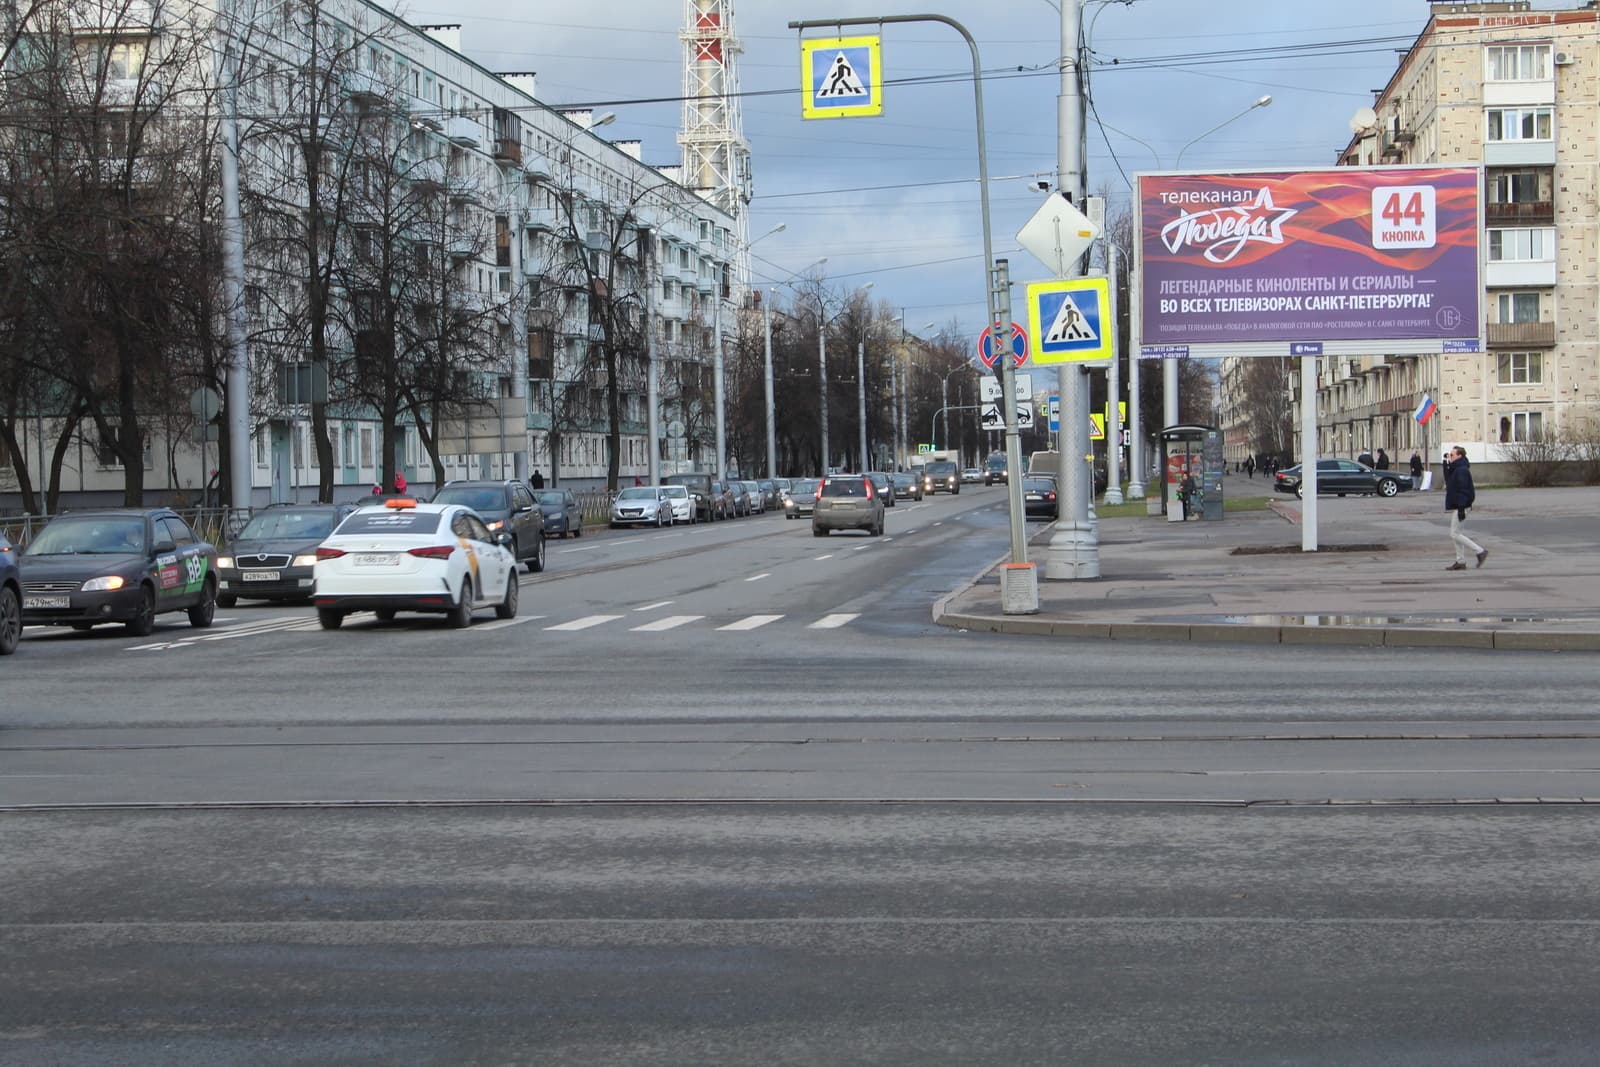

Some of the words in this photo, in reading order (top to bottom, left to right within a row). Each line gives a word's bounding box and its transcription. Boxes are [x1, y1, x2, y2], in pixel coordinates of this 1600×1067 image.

[1160, 189, 1253, 204] телеканал
[1382, 192, 1425, 226] 44
[1382, 230, 1425, 242] КНОПКА
[1160, 279, 1253, 296] ЛЕГЕНДАРНЫЕ
[1256, 277, 1336, 293] КИНОЛЕНТЫ
[1340, 277, 1349, 291] И
[1352, 275, 1414, 291] СЕРИАЛЫ
[1160, 299, 1178, 313] ВО
[1181, 298, 1211, 313] ВСЕХ
[1214, 296, 1302, 312] ТЕЛЕВИЗОРАХ
[1311, 321, 1323, 329] ПАО
[1443, 310, 1459, 326] 16+
